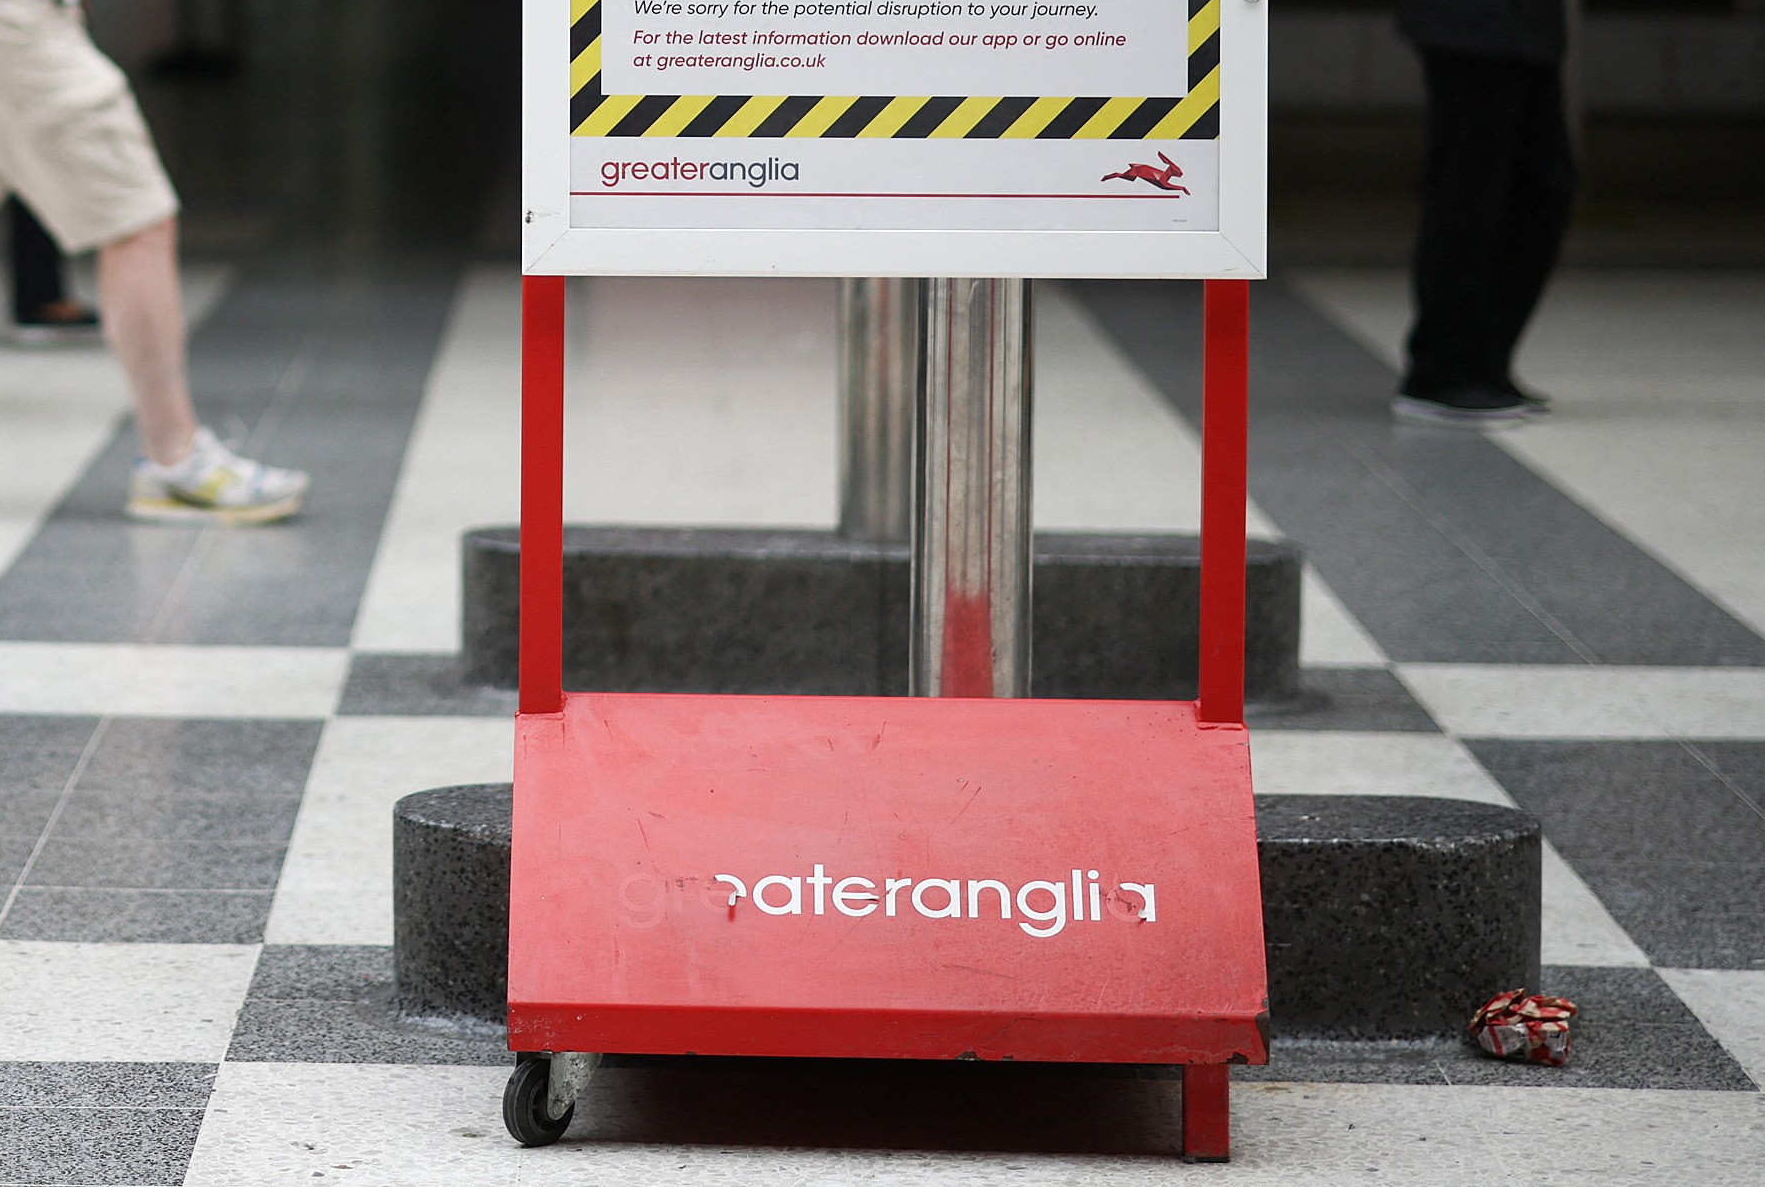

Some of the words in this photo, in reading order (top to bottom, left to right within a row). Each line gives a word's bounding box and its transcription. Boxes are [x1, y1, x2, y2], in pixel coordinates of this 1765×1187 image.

[687, 3, 729, 19] sorry
[733, 0, 757, 15] for
[761, 0, 790, 15] the
[793, 0, 873, 19] potential
[876, 0, 962, 20] disruption
[967, 2, 985, 16] to
[989, 4, 1029, 20] your
[1030, 1, 1098, 20] journey.
[633, 30, 661, 45] For
[665, 30, 694, 45] the
[698, 29, 748, 45] latest
[752, 30, 852, 46] information
[856, 30, 945, 46] download
[948, 34, 978, 46] our
[982, 34, 1018, 50] app
[1022, 35, 1042, 46] or
[1045, 35, 1069, 50] go
[1073, 31, 1127, 47] online
[633, 54, 653, 67] at
[656, 52, 827, 72] greateranglia.co.uk
[600, 156, 799, 188] greateranglia
